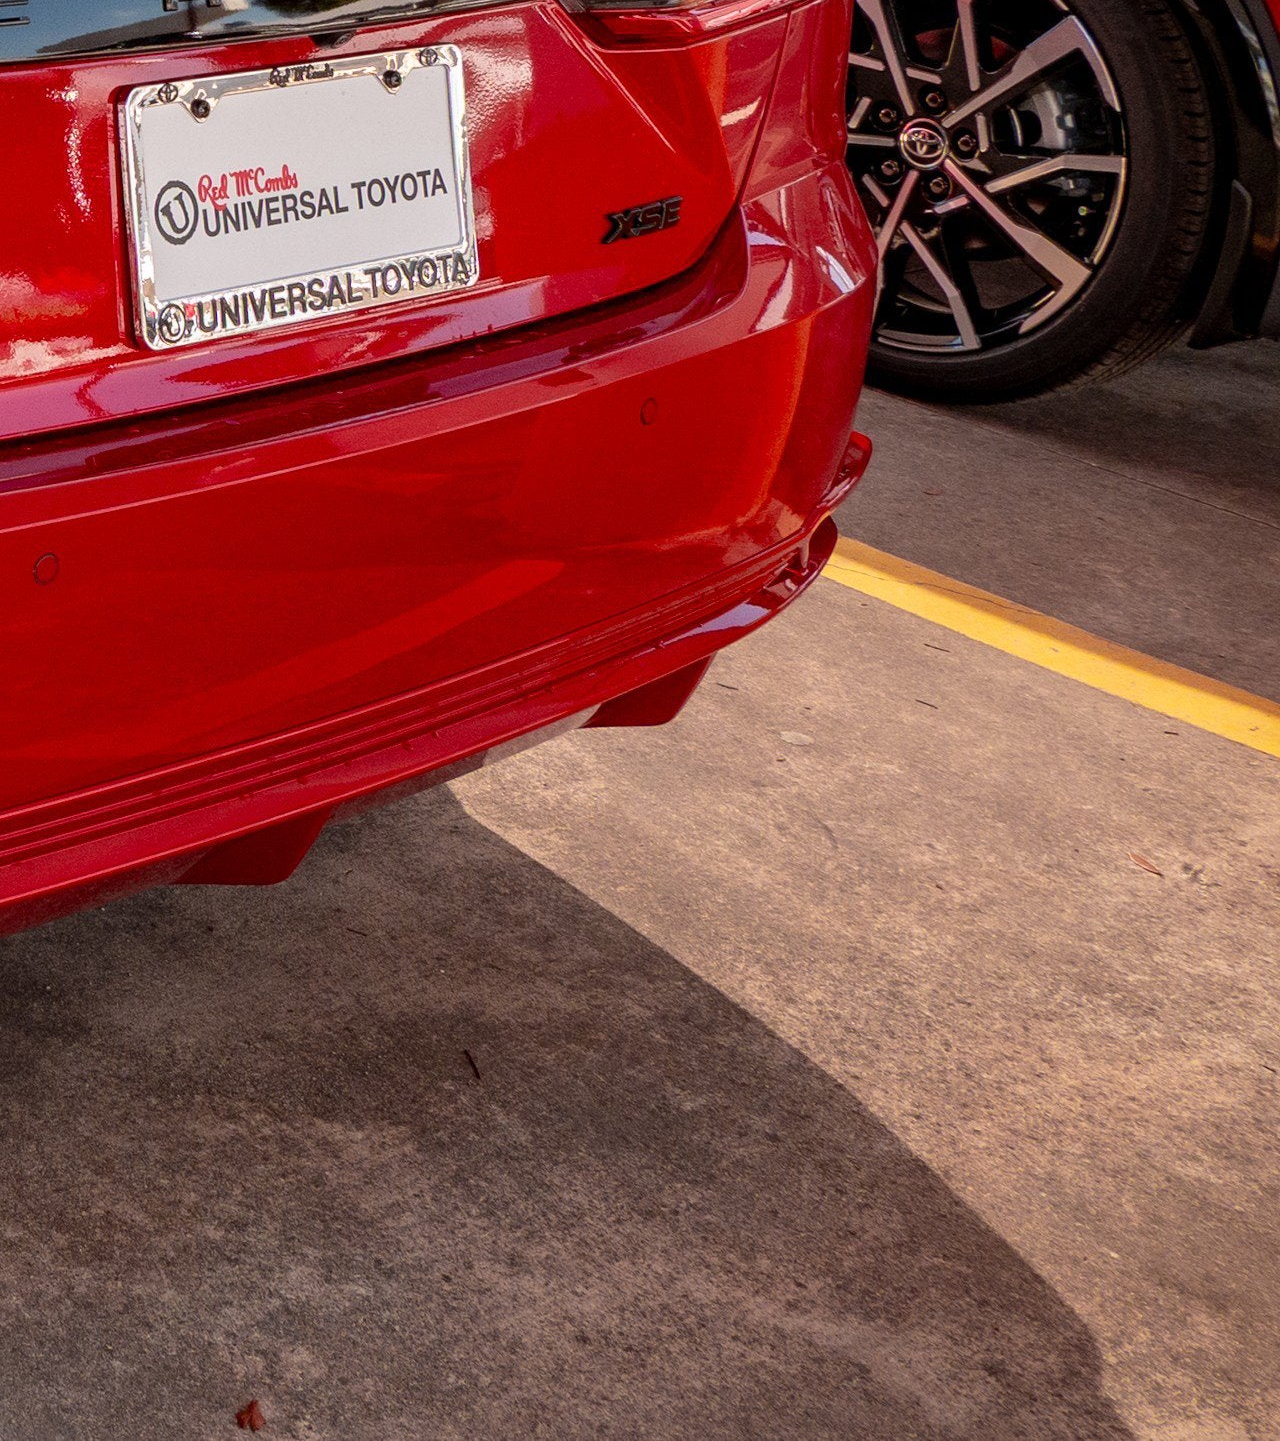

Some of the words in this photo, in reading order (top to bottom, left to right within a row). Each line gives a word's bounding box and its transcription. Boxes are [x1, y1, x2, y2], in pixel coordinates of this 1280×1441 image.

[198, 174, 228, 211] Red
[230, 164, 299, 196] McCombs
[201, 189, 349, 238] UNIVERSAL
[351, 168, 449, 209] TOYOTA
[601, 195, 684, 245] XSE
[196, 272, 363, 334] UNIVERSAL
[363, 251, 471, 296] TOYOTA
